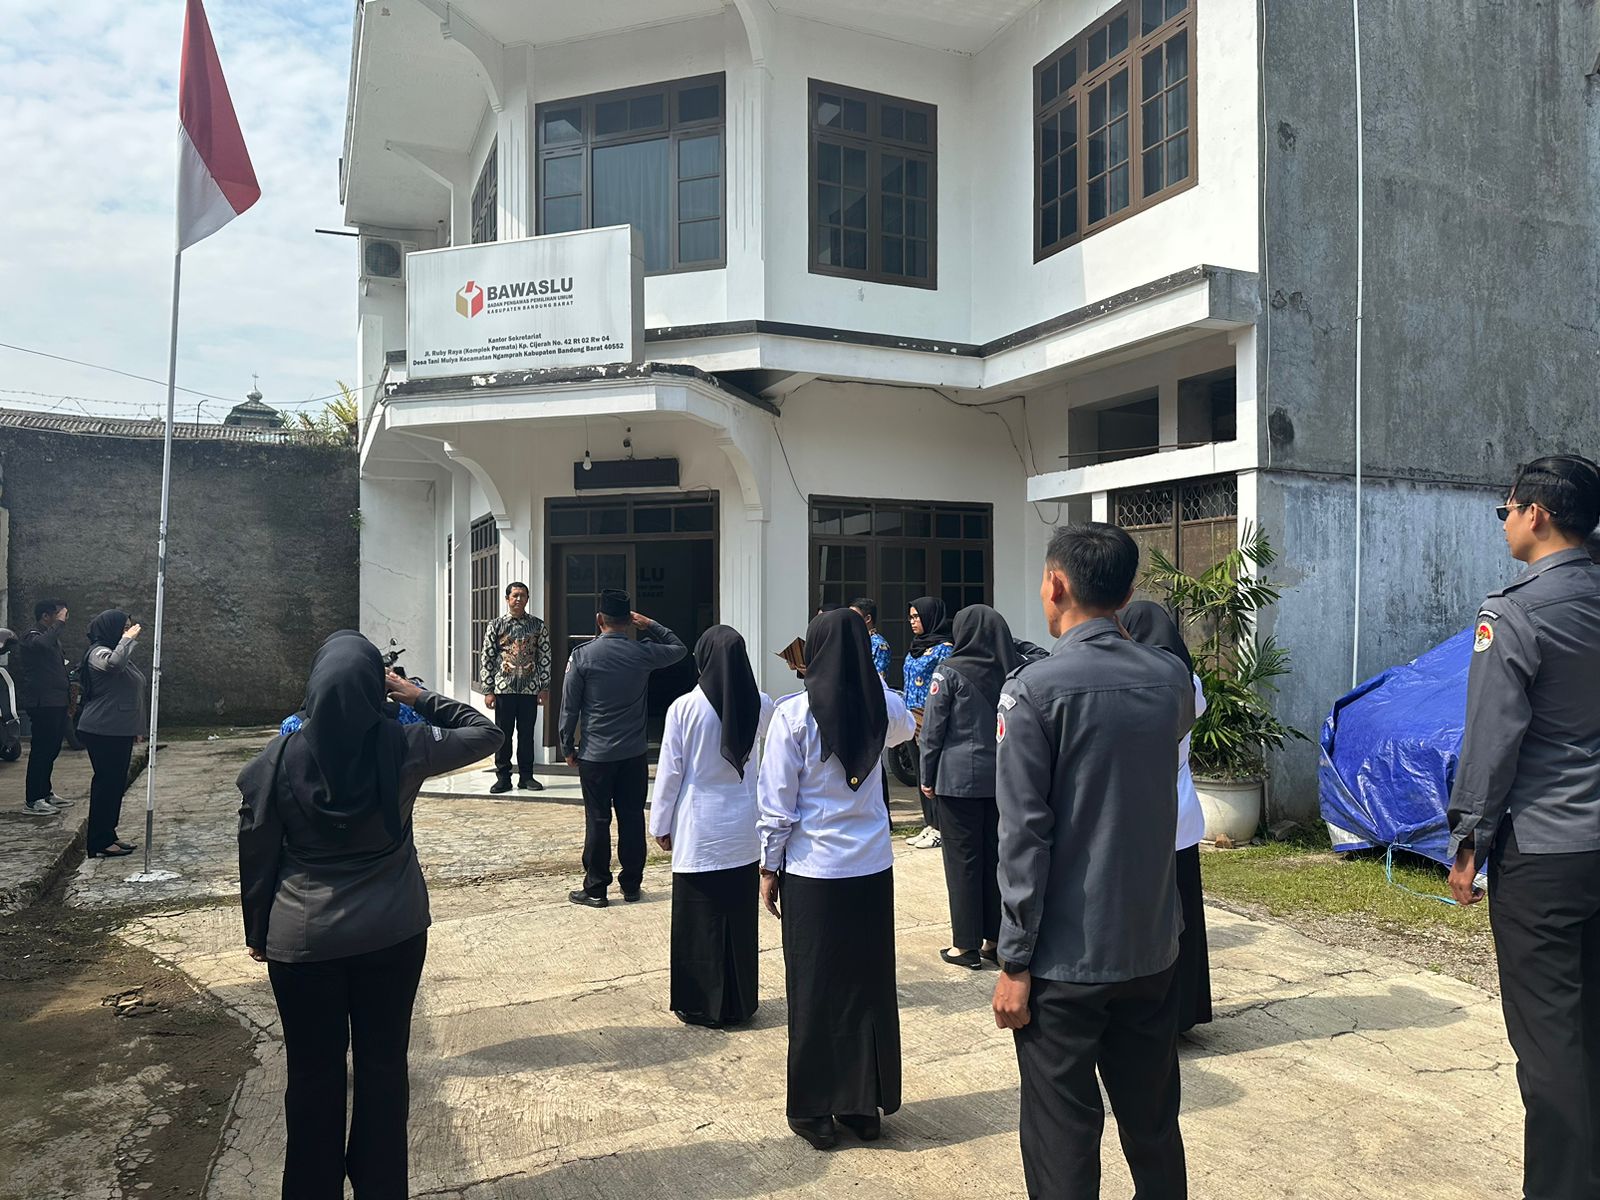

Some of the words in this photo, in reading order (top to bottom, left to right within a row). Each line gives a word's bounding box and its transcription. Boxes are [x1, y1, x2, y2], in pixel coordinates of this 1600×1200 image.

[487, 277, 573, 301] BAWASLU
[487, 306, 521, 314] KABUPATEN
[508, 333, 542, 342] Sekretariat
[492, 344, 518, 352] Permata)
[530, 340, 552, 348] Cijerah
[492, 352, 522, 360] Ngamprah
[558, 346, 585, 354] Bandung
